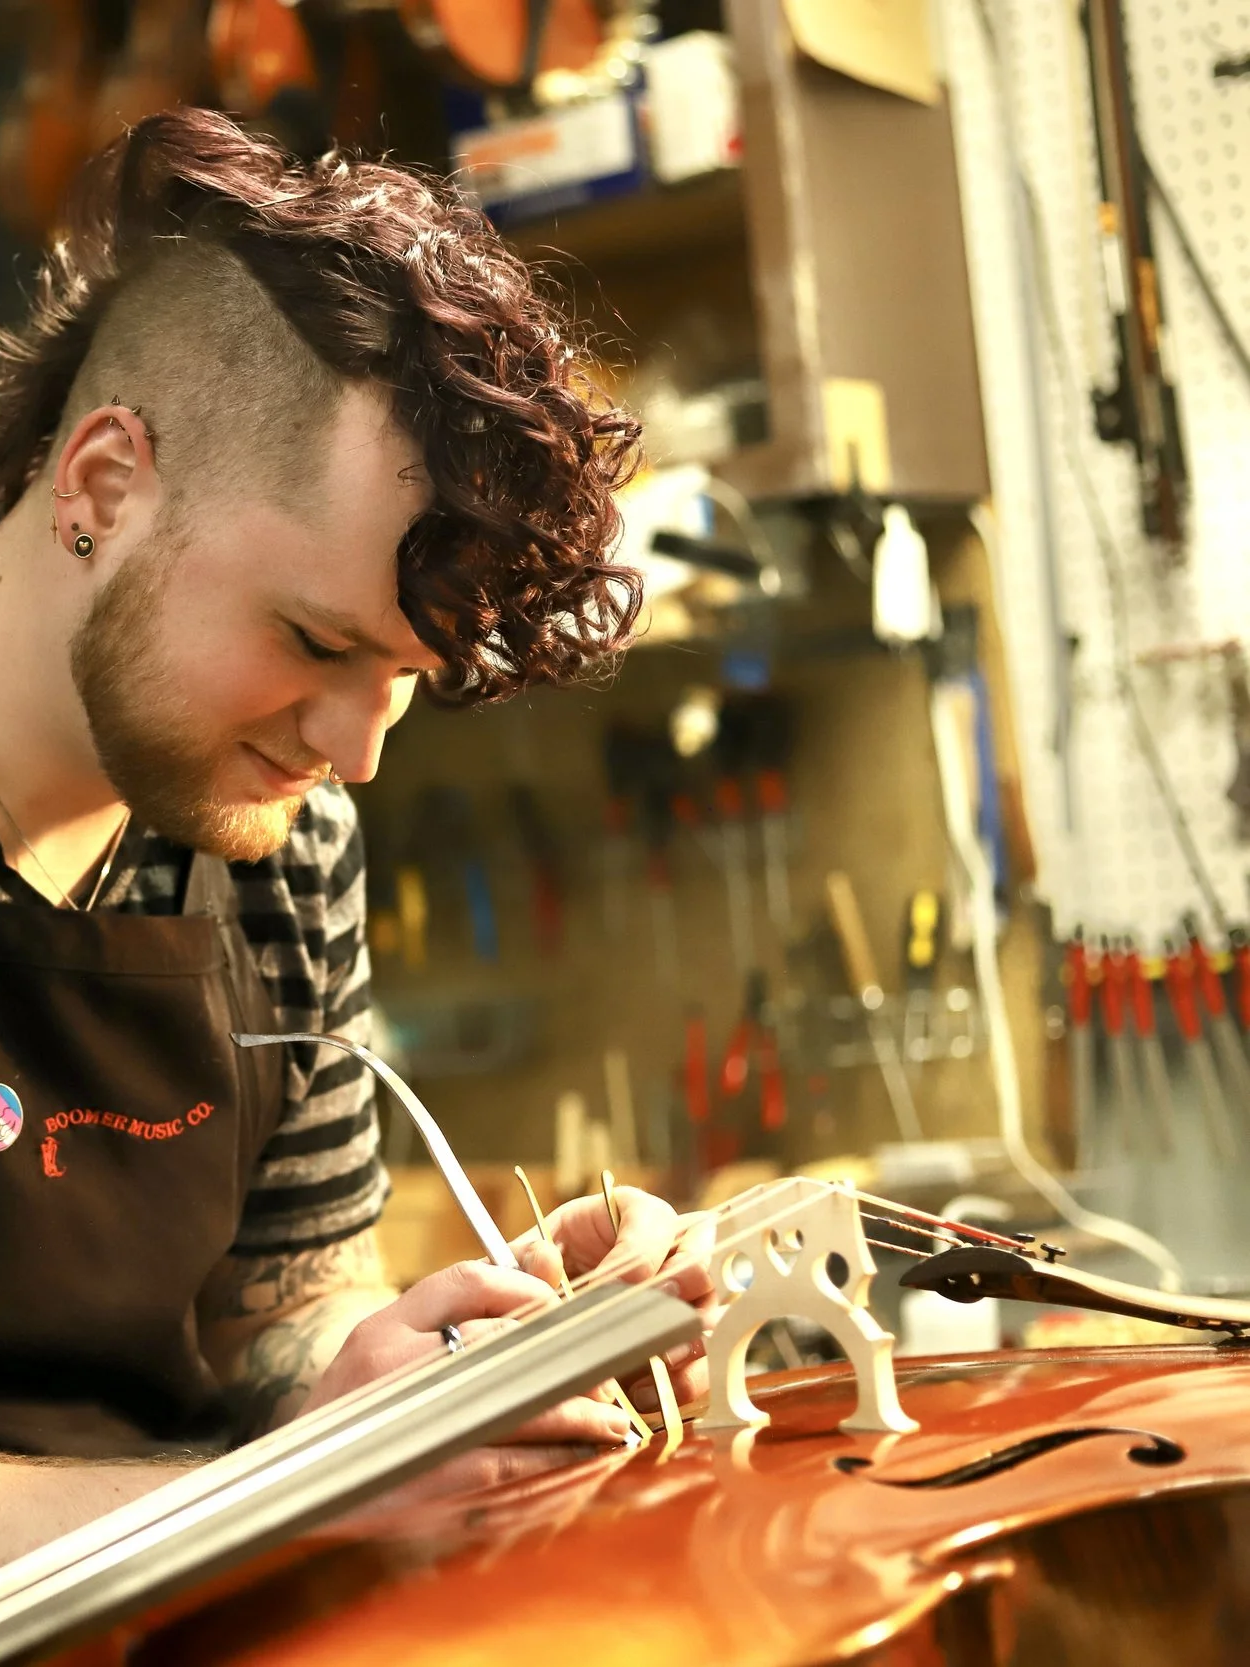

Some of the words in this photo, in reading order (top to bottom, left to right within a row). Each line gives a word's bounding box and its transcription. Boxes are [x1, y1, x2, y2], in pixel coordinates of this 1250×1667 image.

[45, 1108, 128, 1134] BOOMER
[128, 1118, 184, 1140] MUSIC
[186, 1102, 214, 1127] CO.
